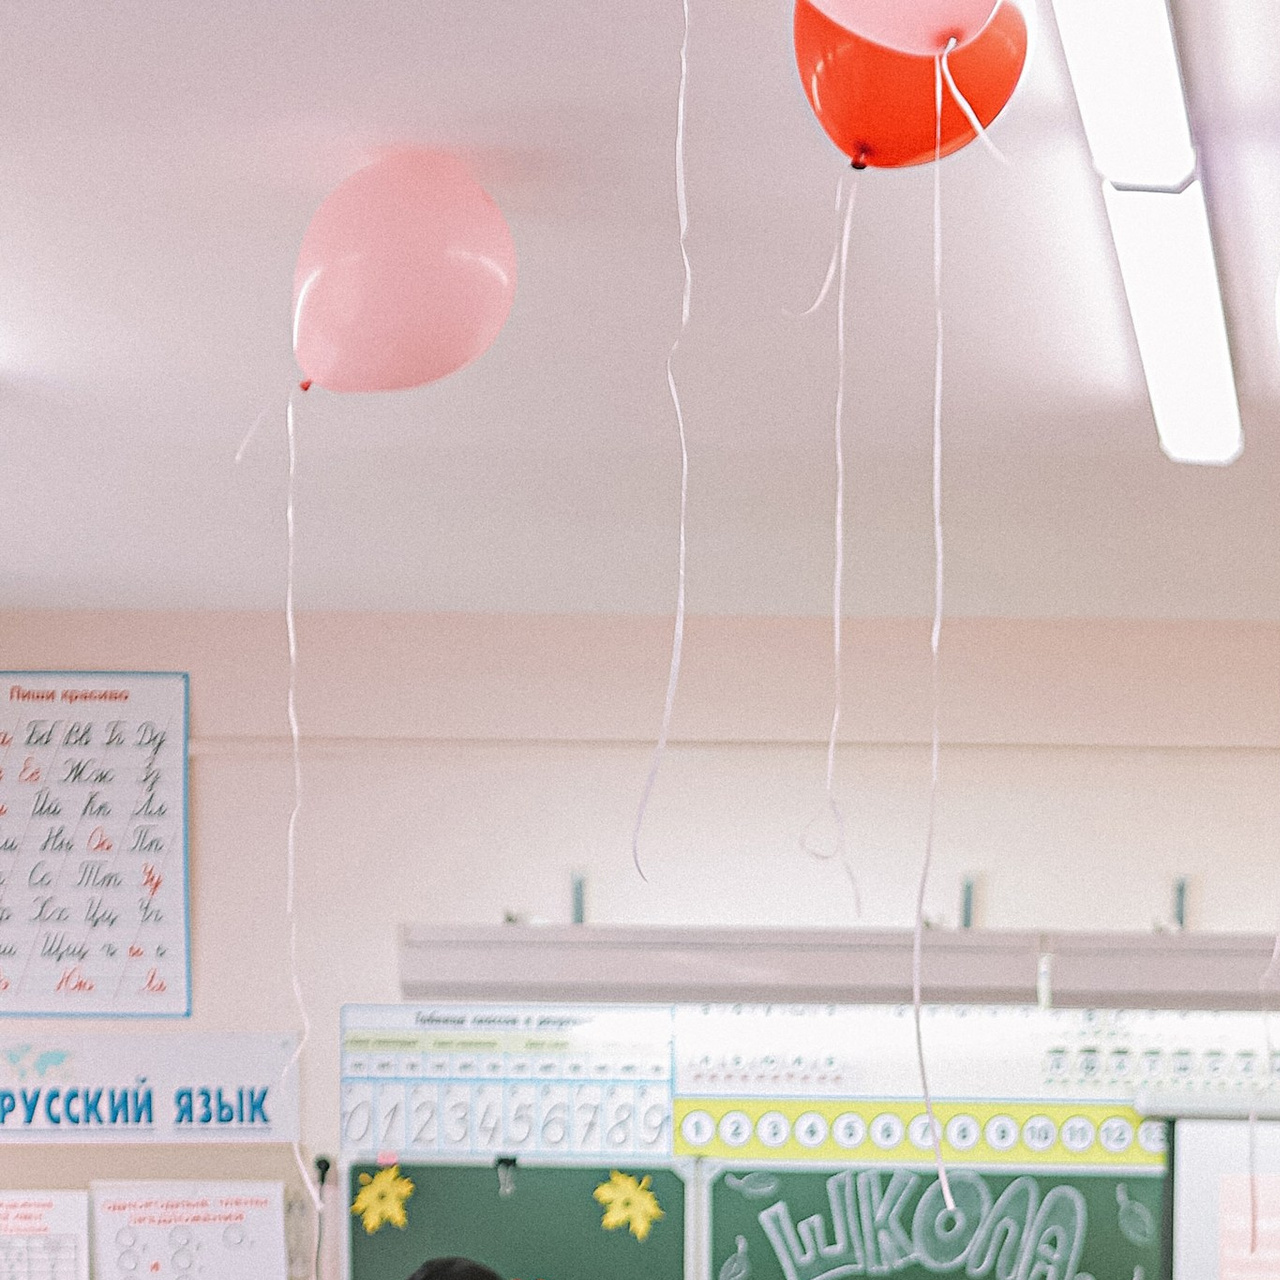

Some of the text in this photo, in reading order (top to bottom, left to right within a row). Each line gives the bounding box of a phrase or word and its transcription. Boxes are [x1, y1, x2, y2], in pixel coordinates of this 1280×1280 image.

[10, 685, 56, 702] Пиши
[0, 1076, 269, 1124] РУССКИЙ ЯЗЫК
[345, 1101, 670, 1146] 0 1 2 3 4 5 6 7 8 9
